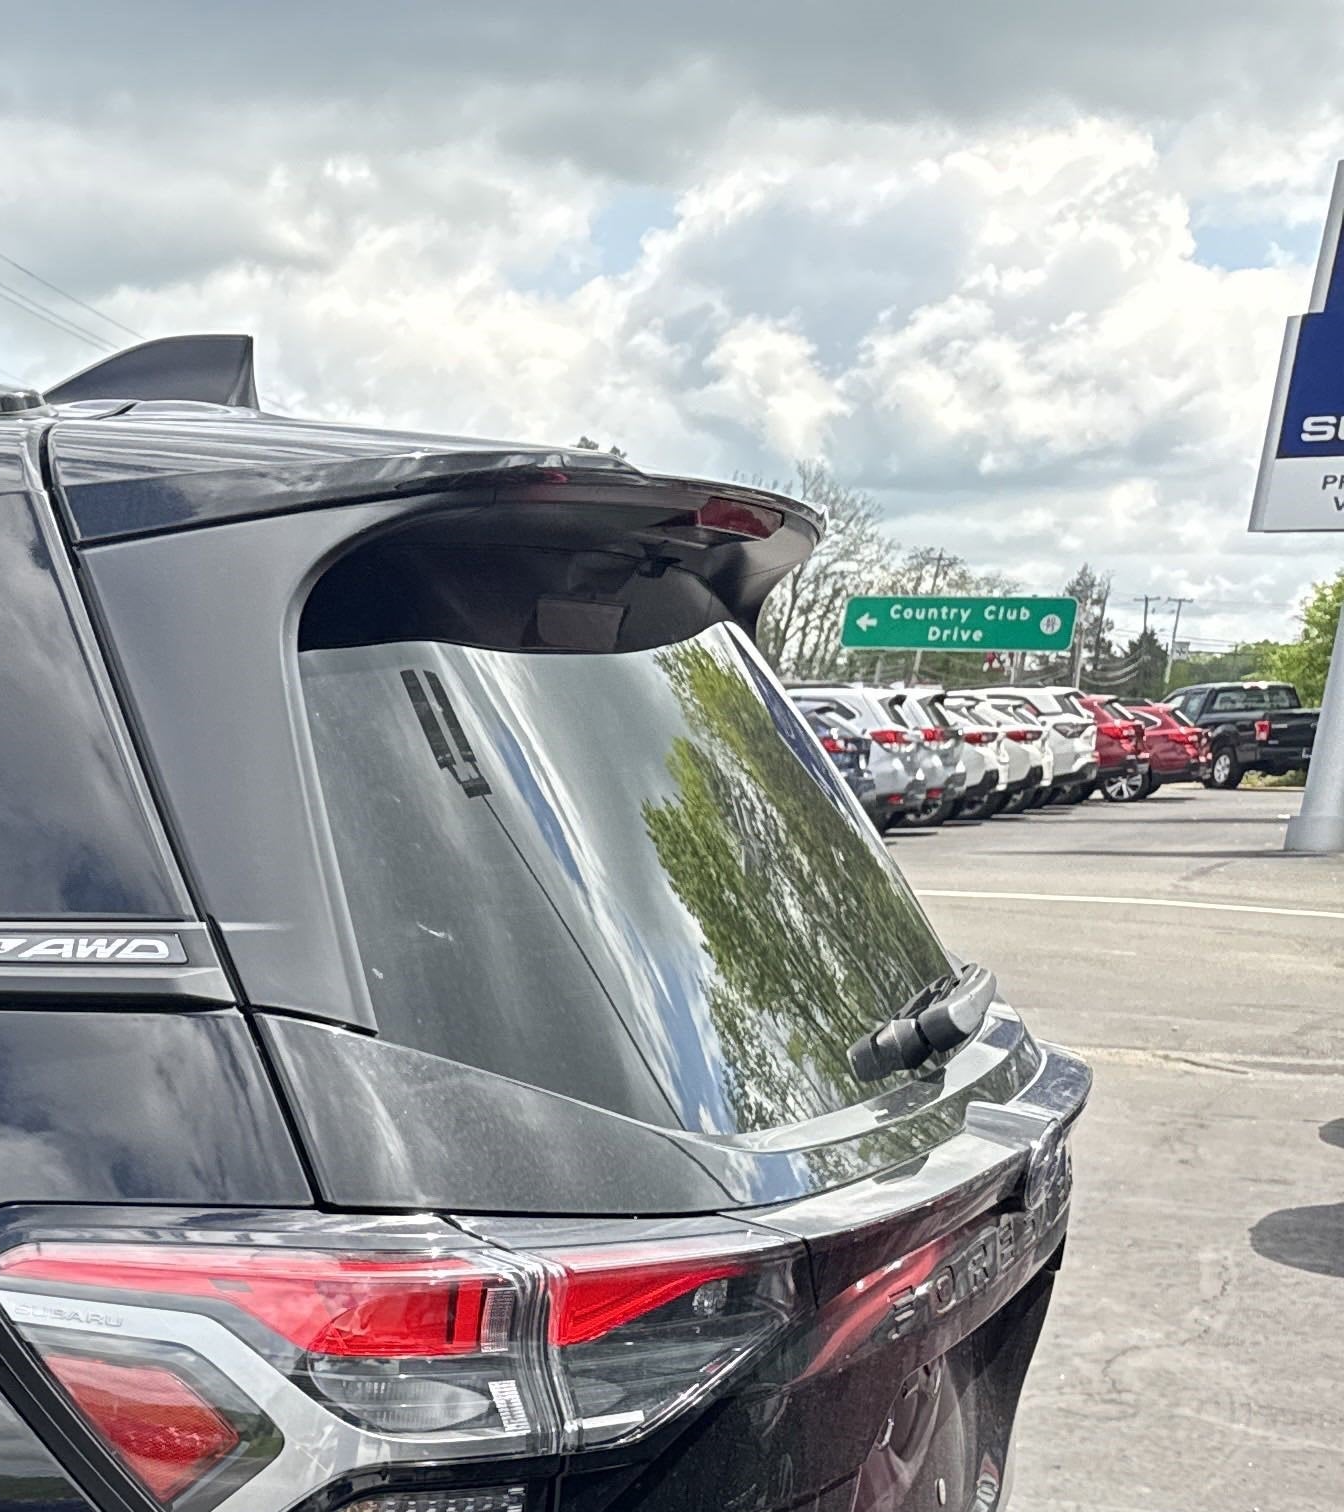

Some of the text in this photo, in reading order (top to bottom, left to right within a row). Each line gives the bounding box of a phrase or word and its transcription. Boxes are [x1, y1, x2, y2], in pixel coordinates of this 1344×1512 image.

[1300, 415, 1344, 442] S
[890, 604, 1031, 622] Country Club
[927, 626, 983, 642] Drive
[18, 938, 169, 958] AWD
[13, 1303, 126, 1328] SUBARU
